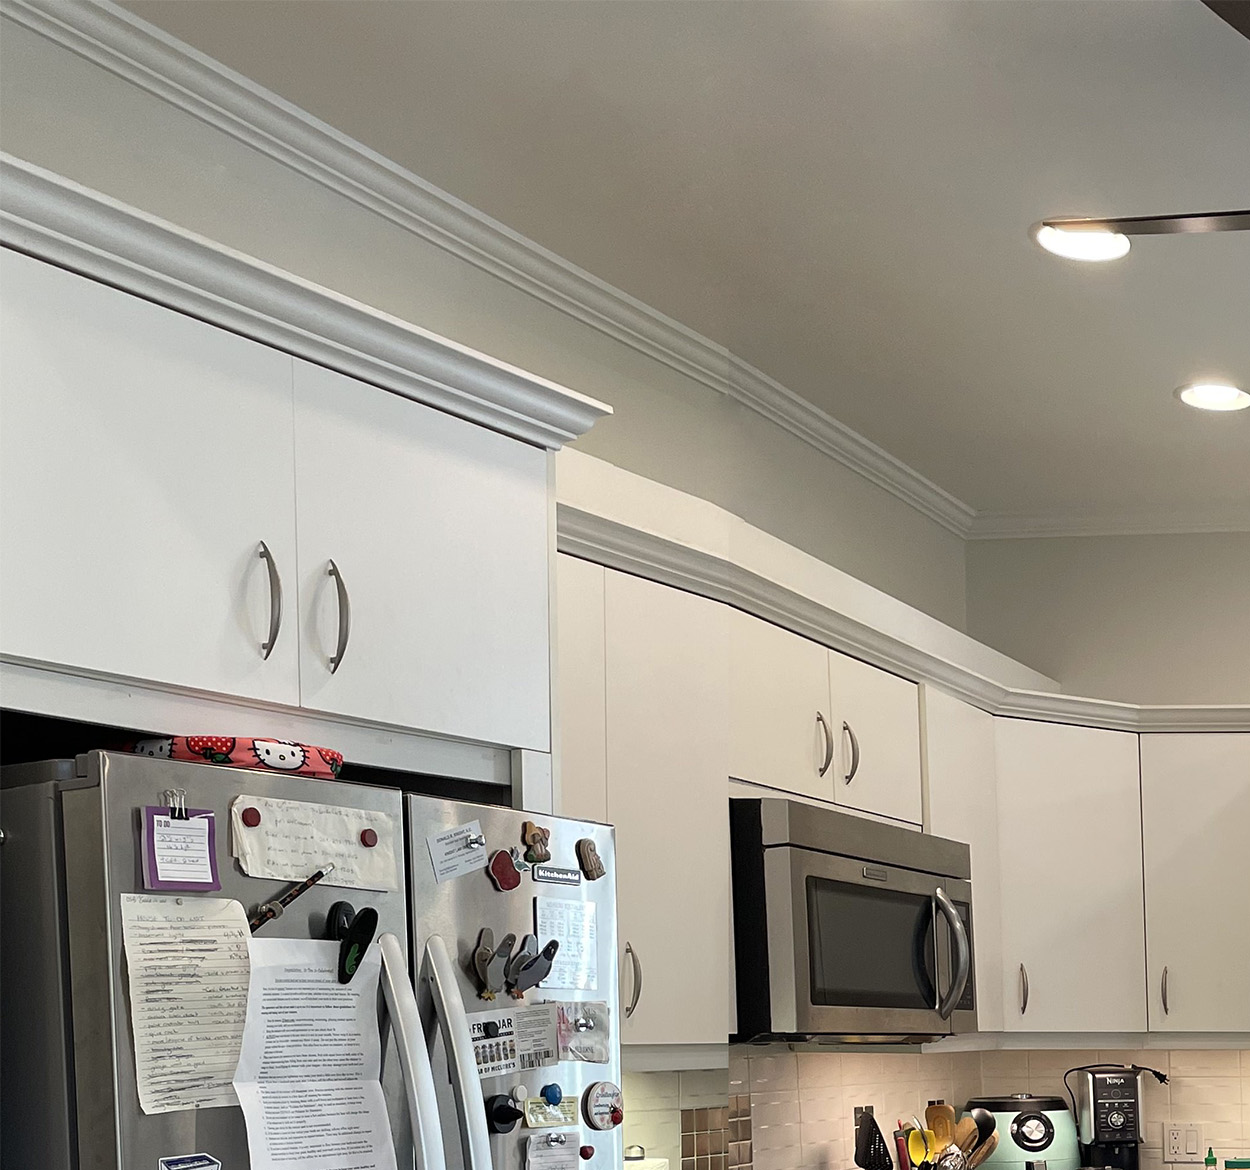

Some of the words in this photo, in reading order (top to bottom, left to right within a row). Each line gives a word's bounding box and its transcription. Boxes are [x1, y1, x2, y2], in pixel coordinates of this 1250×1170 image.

[156, 820, 163, 828] TO
[163, 820, 171, 828] DO
[538, 869, 580, 880] KitchenAid
[498, 1018, 513, 1030] JAR
